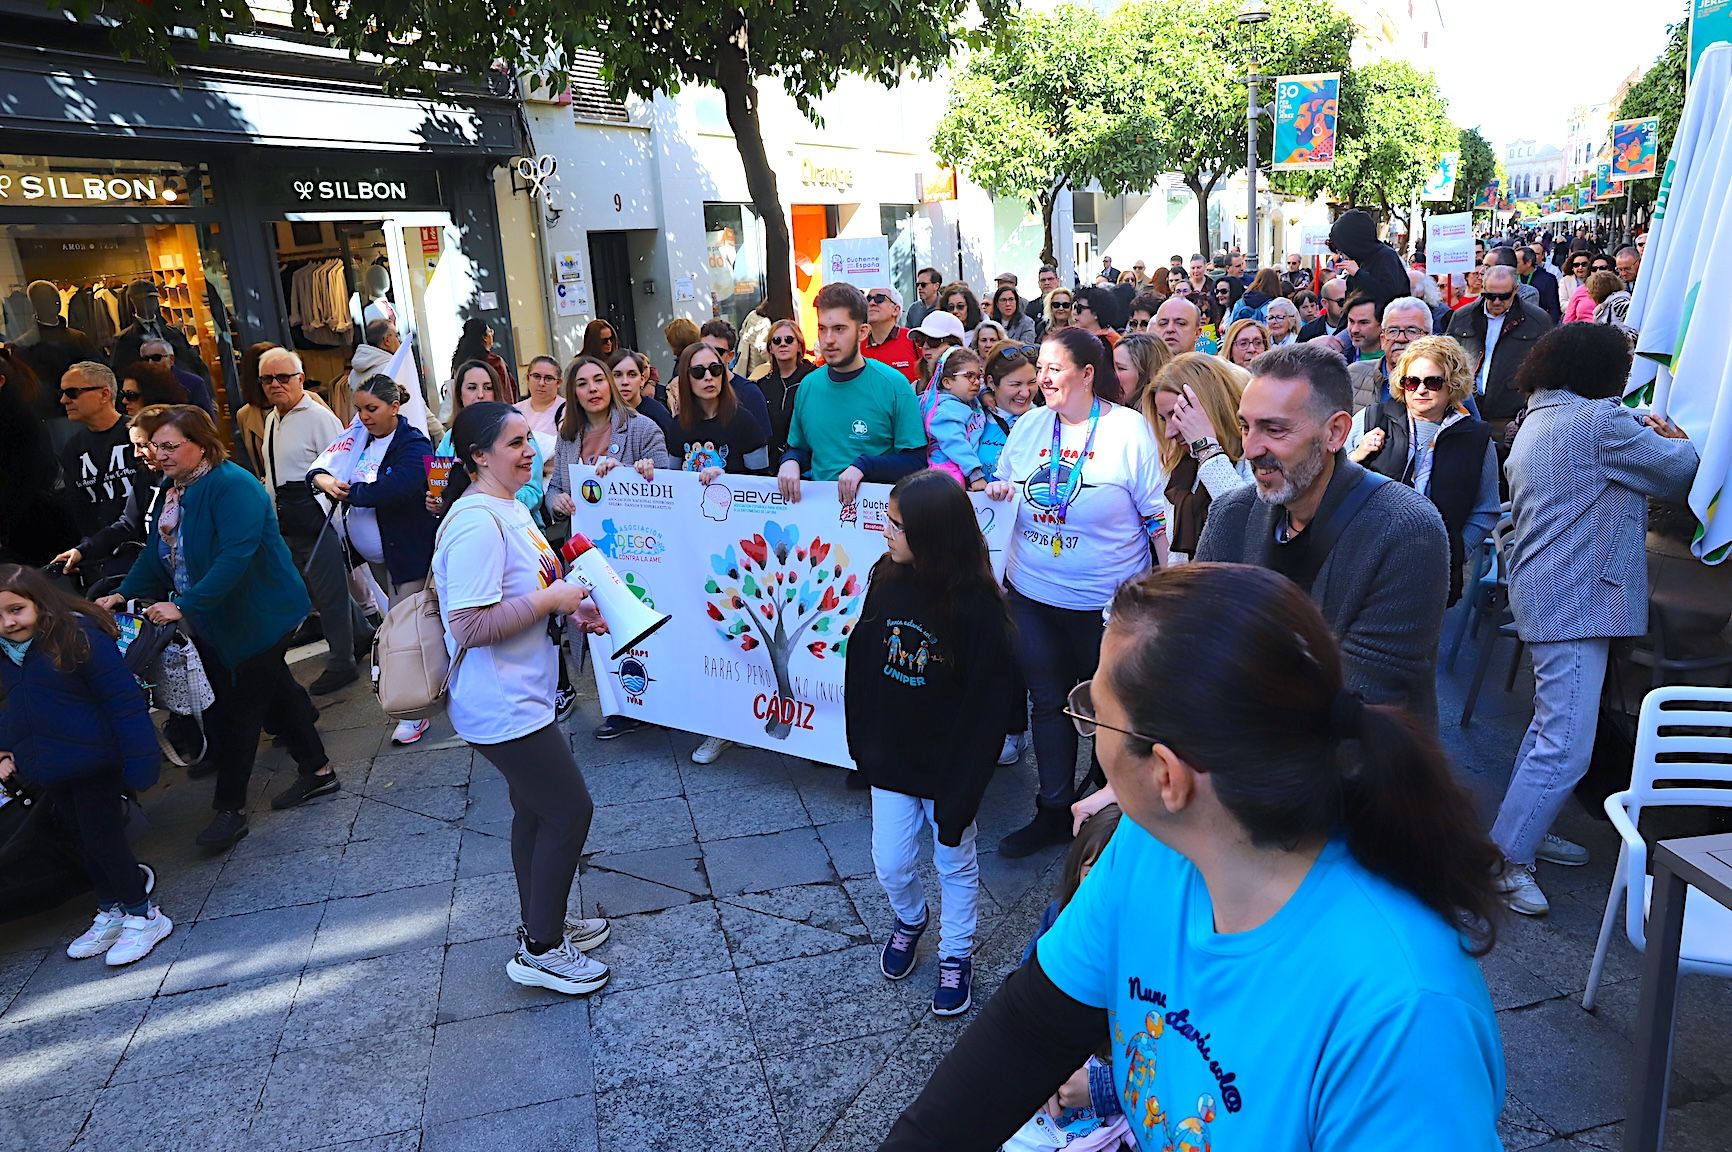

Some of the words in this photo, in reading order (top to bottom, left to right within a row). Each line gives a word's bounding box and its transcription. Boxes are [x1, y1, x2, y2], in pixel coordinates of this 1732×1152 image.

[1279, 84, 1299, 100] 30
[1642, 122, 1656, 133] 30
[21, 174, 156, 200] SILBON
[318, 181, 406, 199] SILBON
[614, 193, 622, 212] 9
[608, 482, 673, 498] ANSEDH
[863, 499, 888, 510] Duche
[1066, 536, 1079, 549] 37
[704, 656, 740, 682] RARAS
[747, 664, 771, 688] PERO
[795, 676, 808, 698] NO
[816, 680, 845, 704] INVIS
[884, 664, 926, 686] UNIPER
[753, 690, 816, 730] CÁDIZ
[1128, 976, 1166, 1008] Nunc
